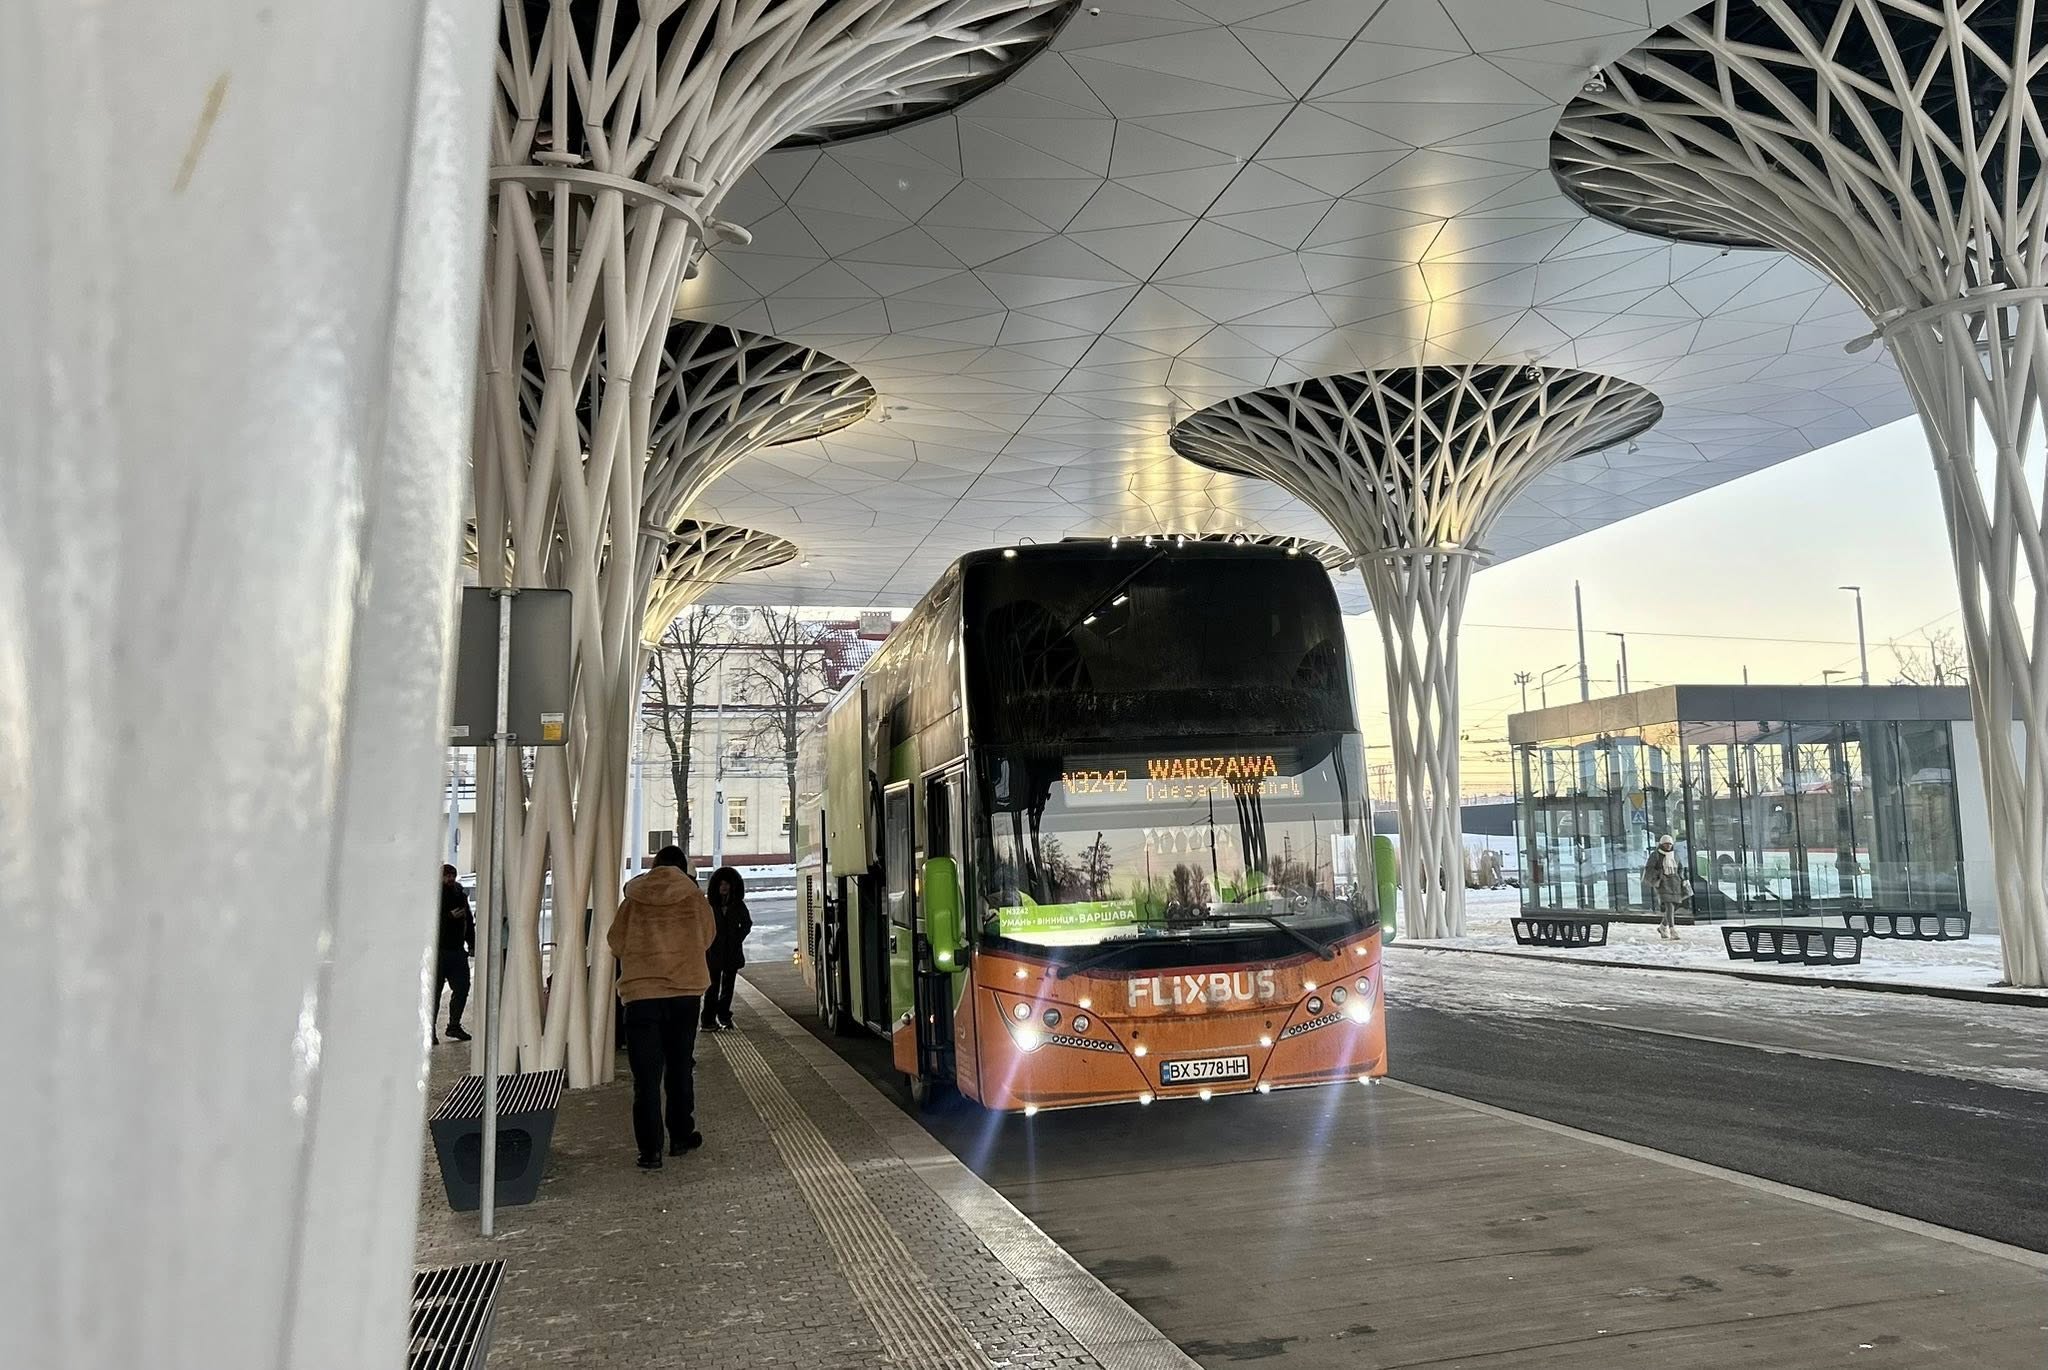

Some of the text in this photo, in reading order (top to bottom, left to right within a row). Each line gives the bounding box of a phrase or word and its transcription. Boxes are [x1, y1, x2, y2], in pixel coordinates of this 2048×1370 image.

[1148, 755, 1278, 780] WARSZAWA
[1062, 770, 1128, 794] N3242
[1001, 918, 1032, 928] УМАНЬ
[1079, 910, 1135, 924] ВАРШАВА
[1170, 1063, 1191, 1079] BX
[1193, 1060, 1224, 1077] 5778
[1226, 1058, 1246, 1075] HH
